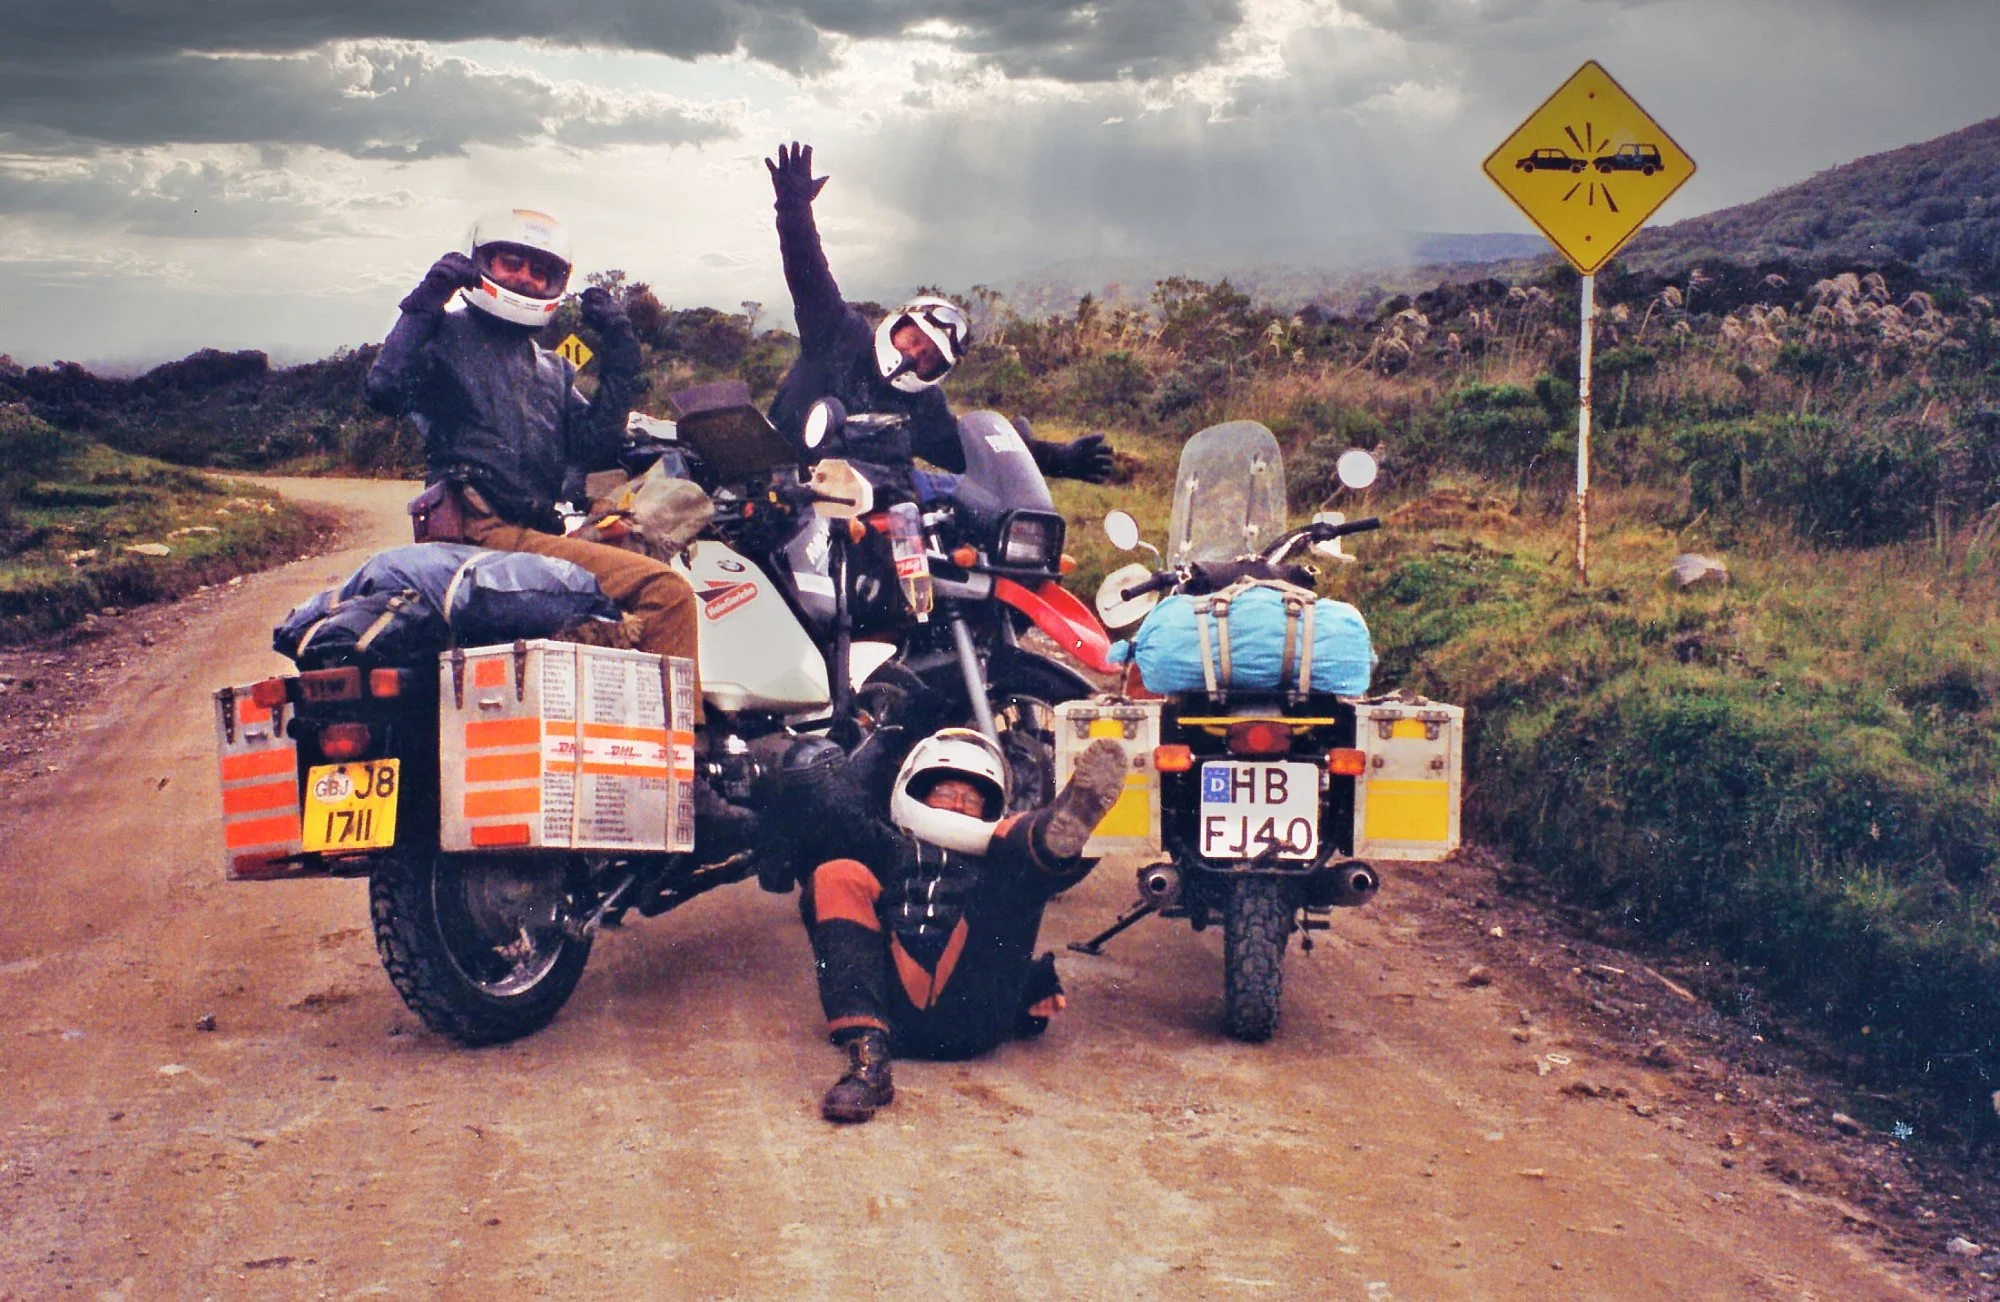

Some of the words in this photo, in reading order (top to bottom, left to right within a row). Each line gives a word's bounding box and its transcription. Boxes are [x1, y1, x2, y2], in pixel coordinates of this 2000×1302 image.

[611, 745, 635, 757] DHL
[315, 779, 349, 798] GBJ
[355, 765, 394, 799] J8
[1211, 778, 1225, 793] D
[325, 808, 373, 844] 1711
[1205, 815, 1313, 856] FJ40
